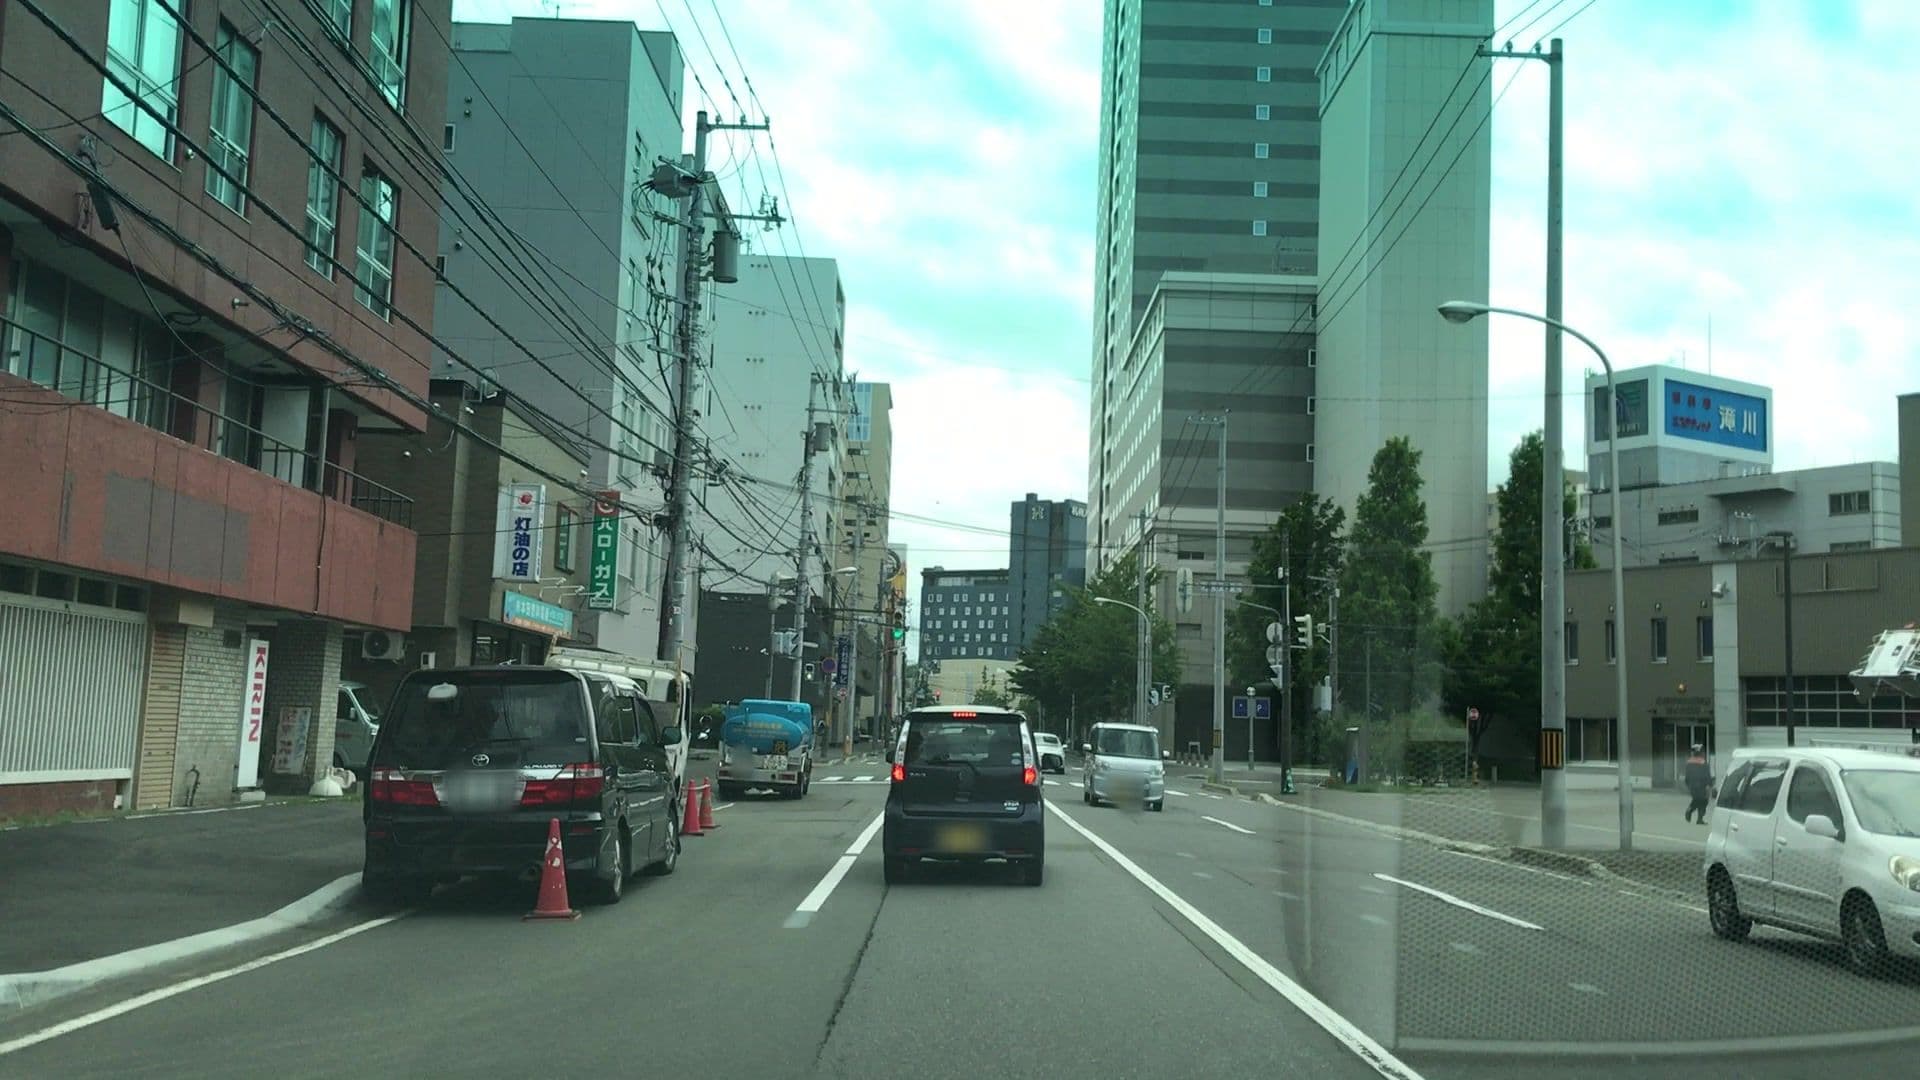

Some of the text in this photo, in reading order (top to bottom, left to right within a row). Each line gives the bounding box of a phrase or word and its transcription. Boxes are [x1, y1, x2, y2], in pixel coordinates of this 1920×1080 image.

[511, 517, 531, 577] 灯油の店
[248, 646, 267, 742] KIRIN
